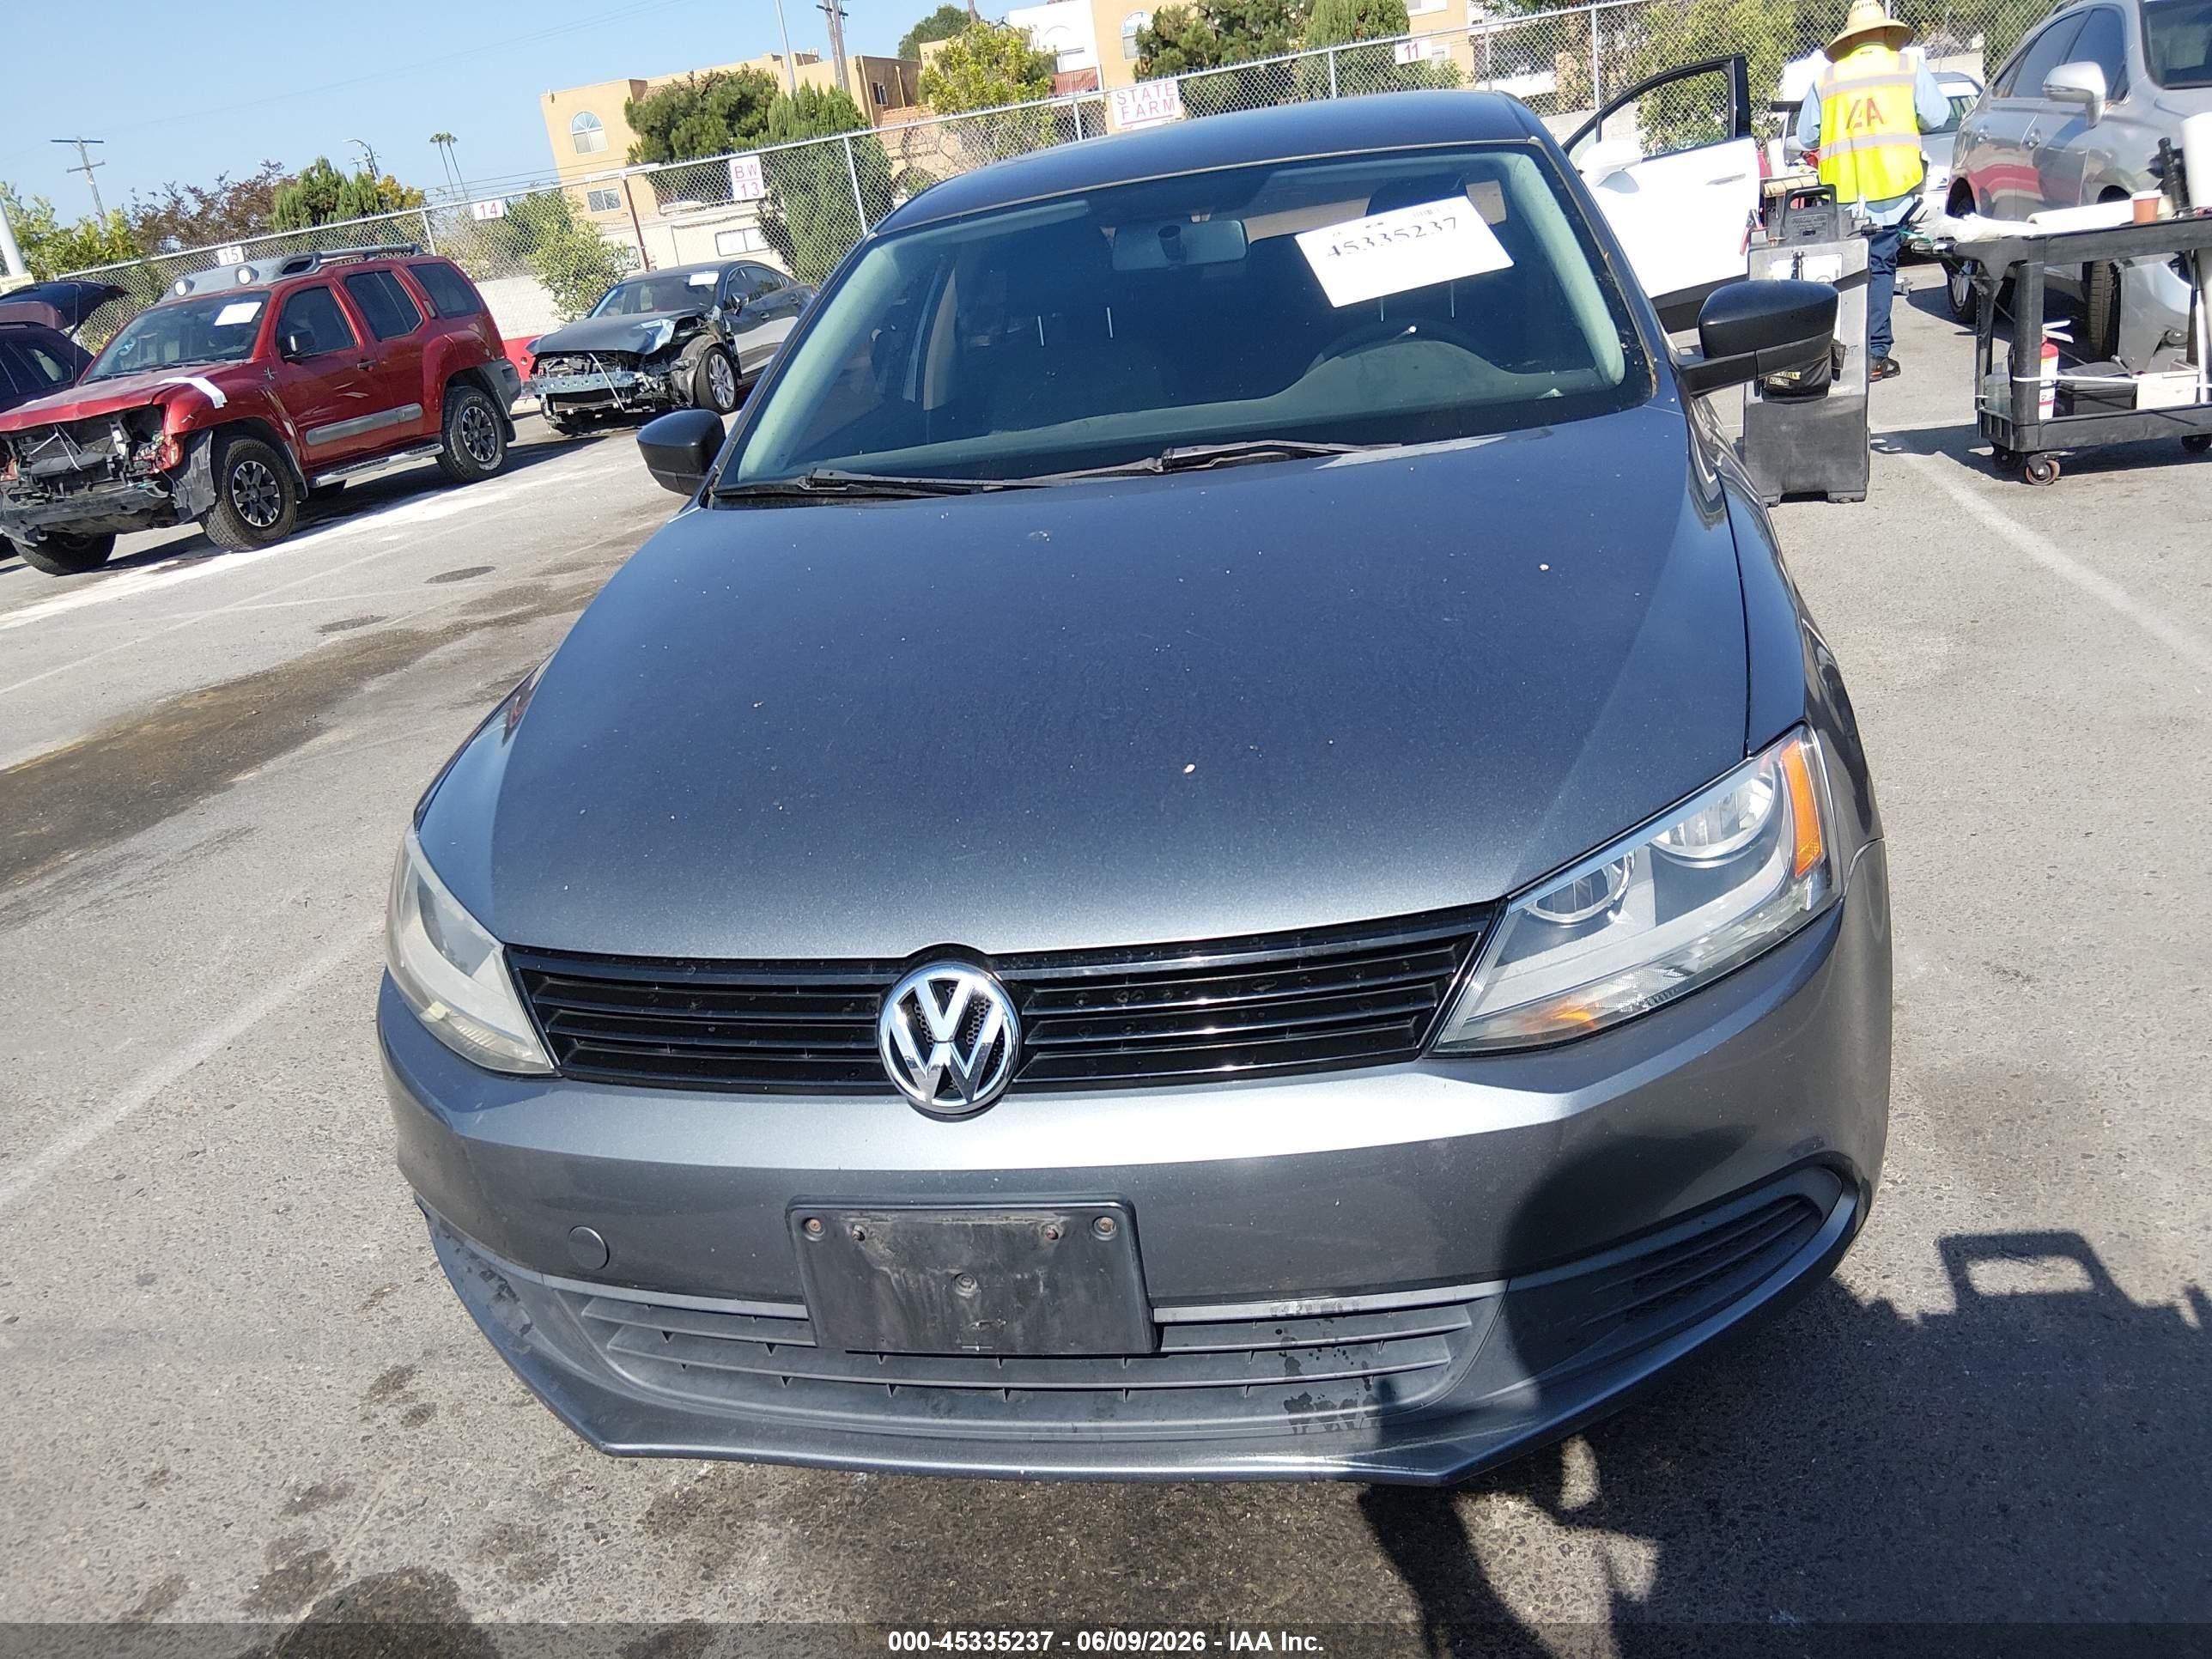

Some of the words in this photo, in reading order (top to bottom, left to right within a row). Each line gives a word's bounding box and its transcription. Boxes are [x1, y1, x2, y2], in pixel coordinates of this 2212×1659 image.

[1404, 42, 1419, 60] 11
[1116, 82, 1176, 106] STATE
[1121, 96, 1176, 120] FARM
[734, 163, 758, 179] BW
[741, 182, 759, 198] 13
[479, 202, 498, 218] 14
[1328, 216, 1457, 257] 45335237
[223, 248, 239, 264] 15
[884, 970, 1013, 1109] VW
